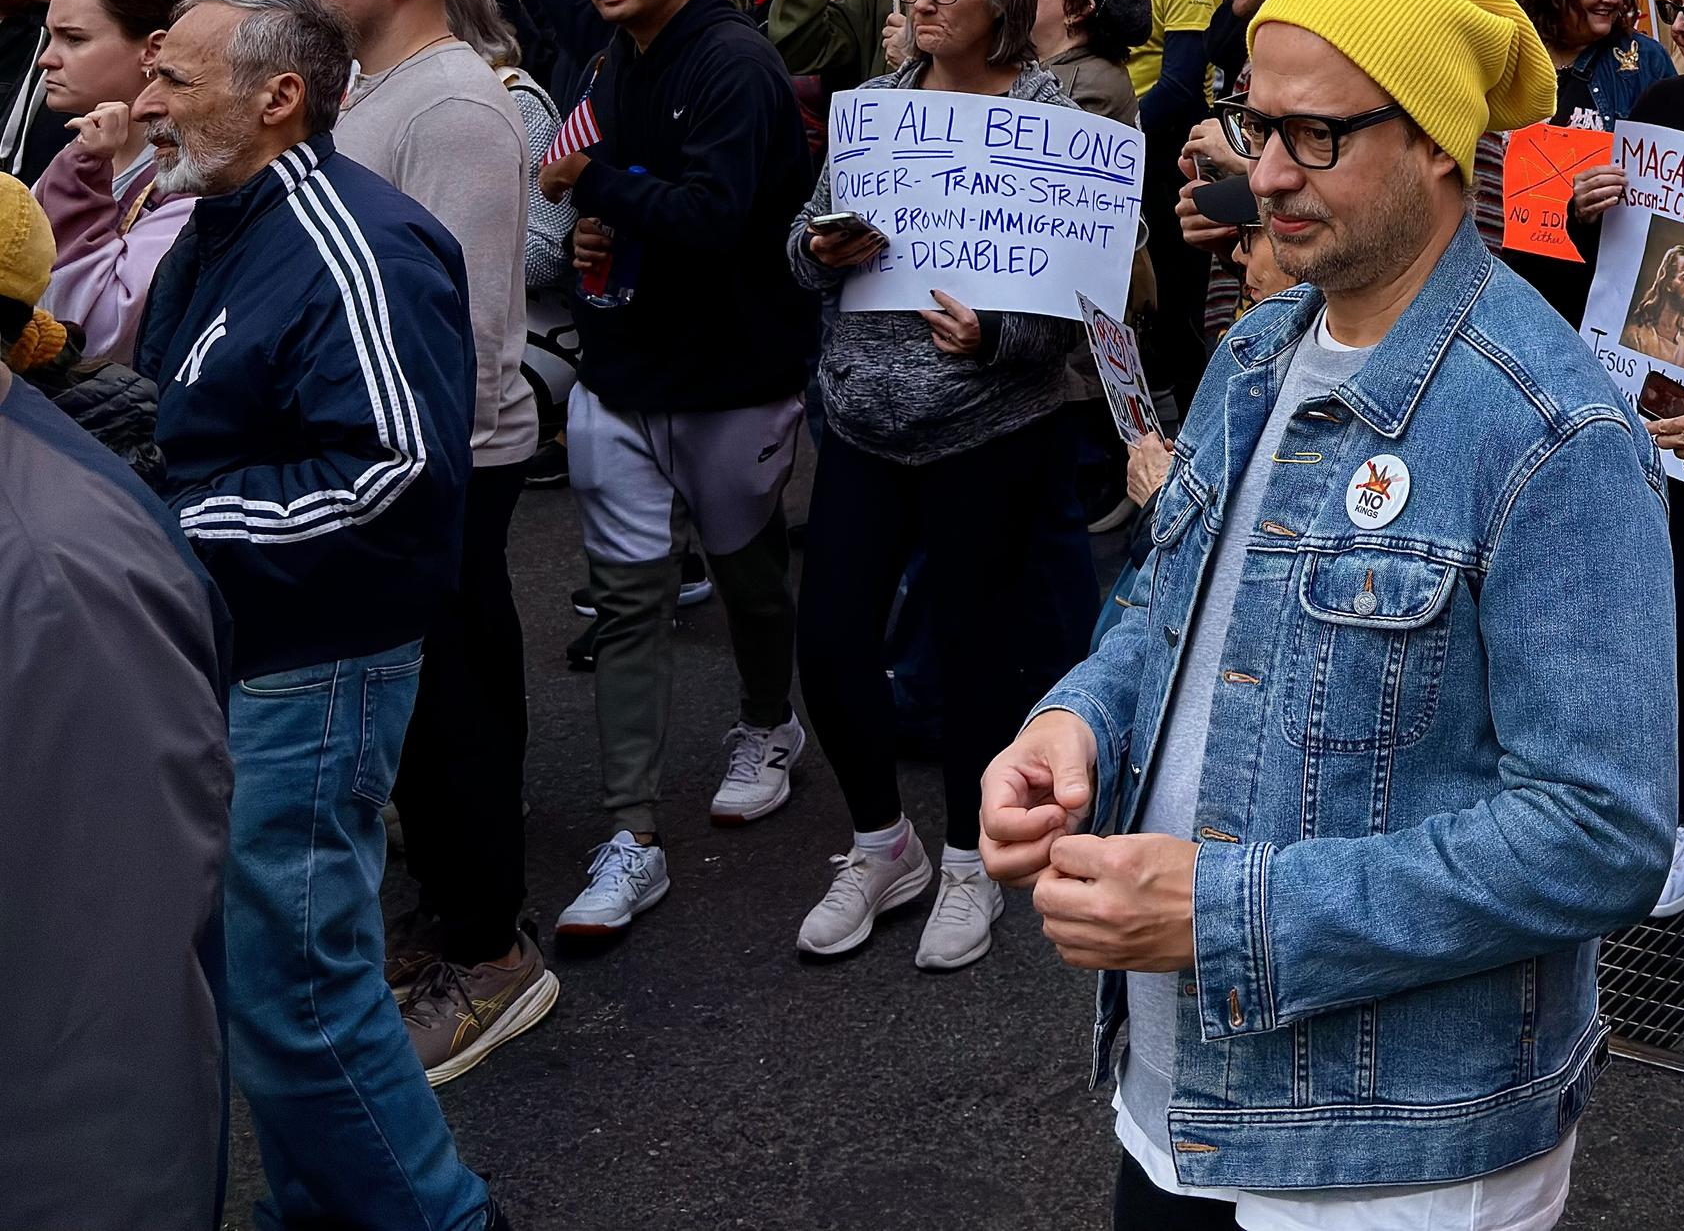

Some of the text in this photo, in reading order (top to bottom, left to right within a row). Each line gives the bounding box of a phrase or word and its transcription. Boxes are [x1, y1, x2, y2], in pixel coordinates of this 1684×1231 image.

[835, 98, 1139, 174] WE ALL BELONG
[1510, 206, 1530, 224] NO
[911, 239, 1049, 277] DISABLED
[1591, 327, 1637, 378] JESUS
[1354, 504, 1379, 519] KINGS
[1358, 490, 1384, 510] NO
